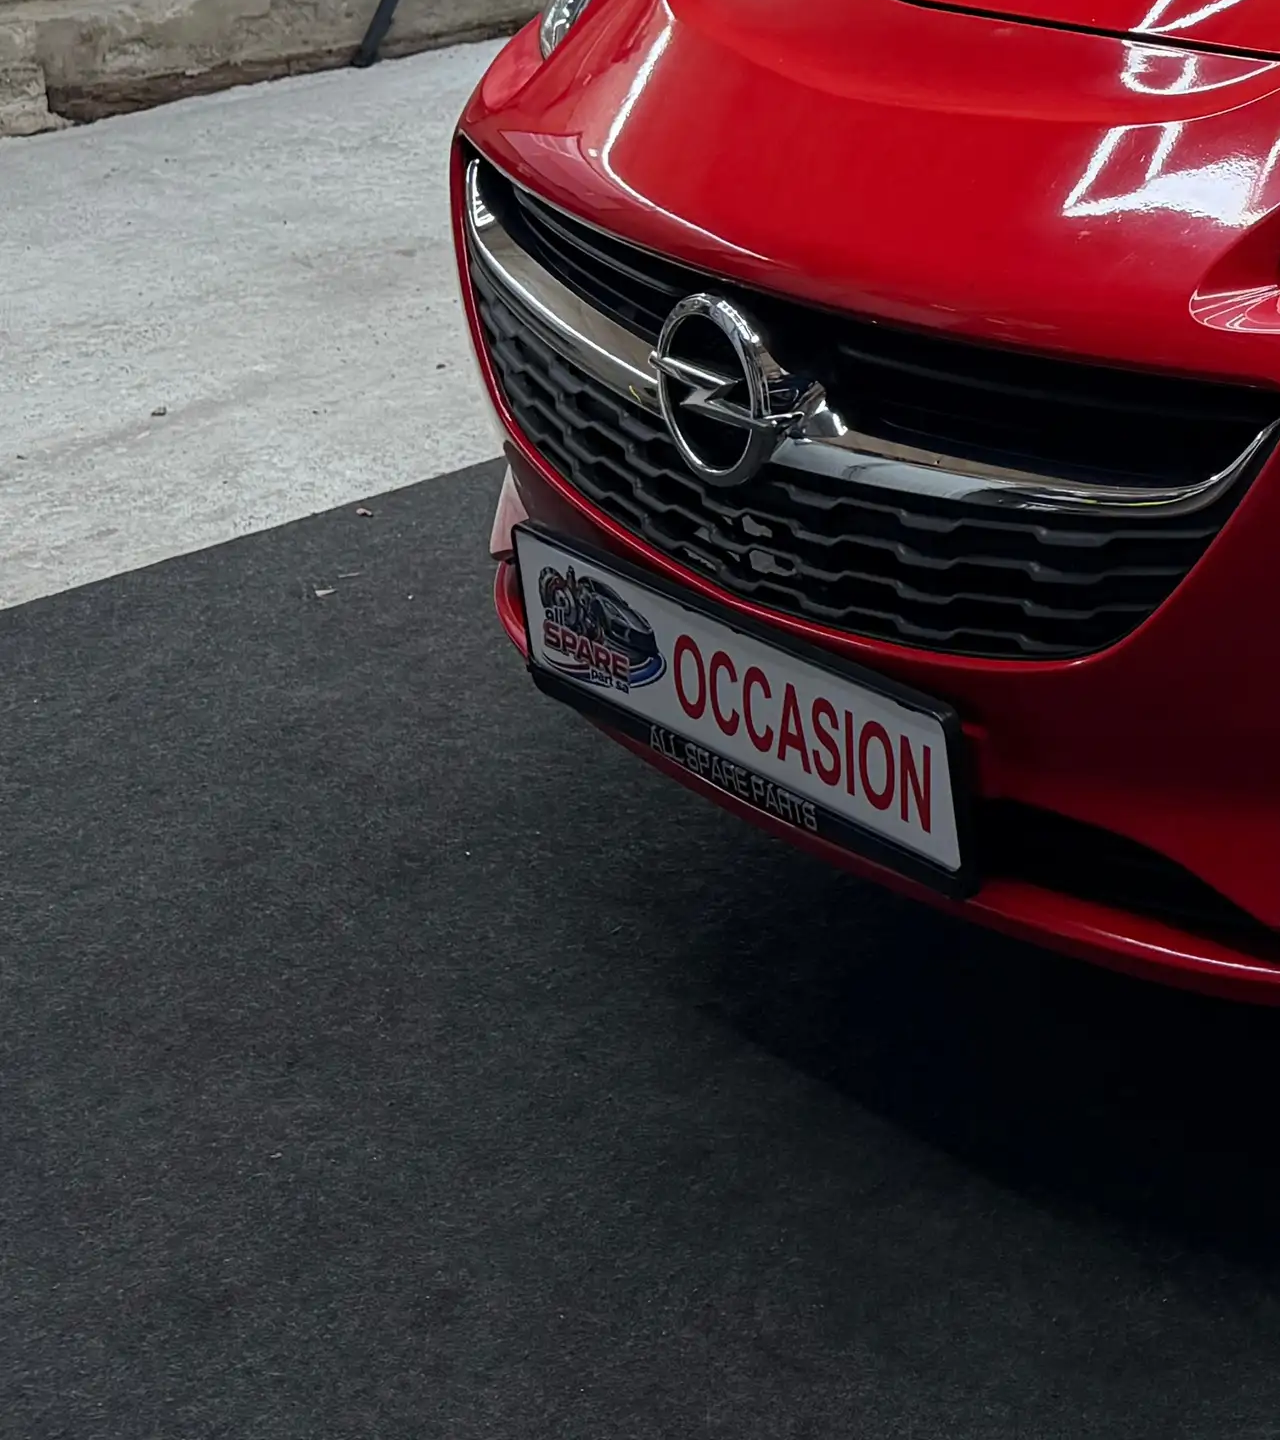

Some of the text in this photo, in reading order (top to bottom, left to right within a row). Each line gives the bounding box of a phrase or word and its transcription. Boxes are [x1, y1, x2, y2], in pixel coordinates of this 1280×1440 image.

[543, 620, 630, 682] SPARE
[545, 608, 564, 625] all
[672, 633, 932, 834] OCCASION
[649, 724, 818, 832] ALL SPARE PARTS
